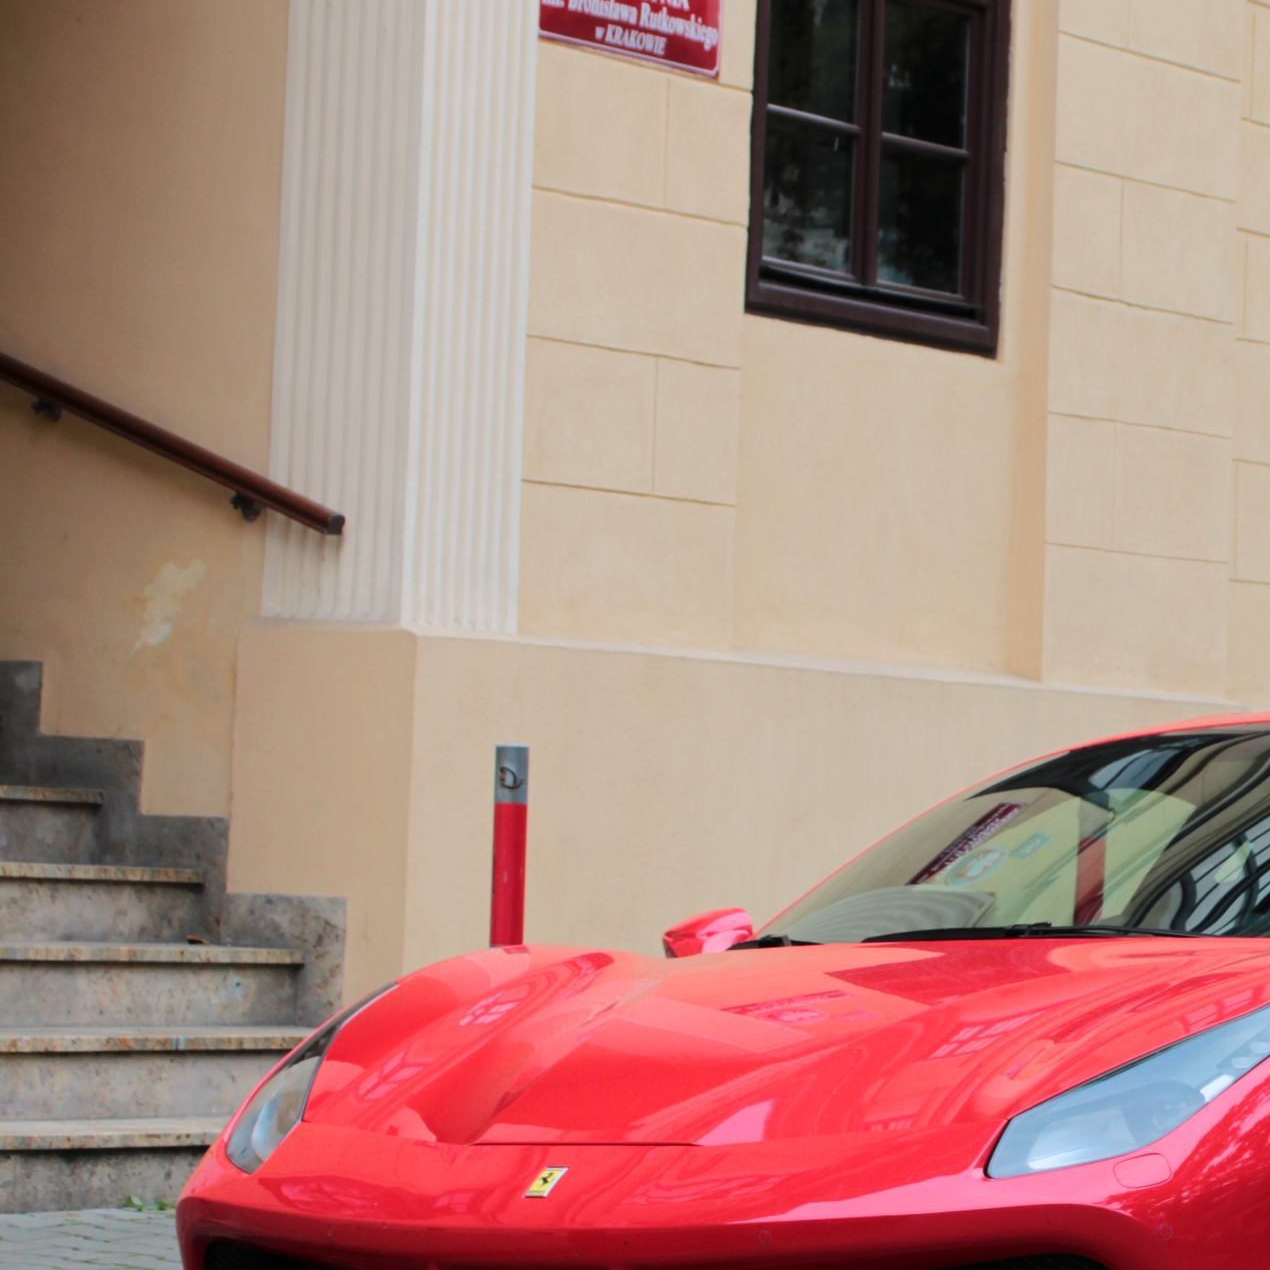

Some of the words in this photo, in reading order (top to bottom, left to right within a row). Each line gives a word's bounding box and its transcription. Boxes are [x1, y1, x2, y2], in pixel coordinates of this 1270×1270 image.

[594, 26, 605, 40] w
[605, 23, 668, 56] KRAKOWIE
[638, 1, 719, 51] Rutkowskiego
